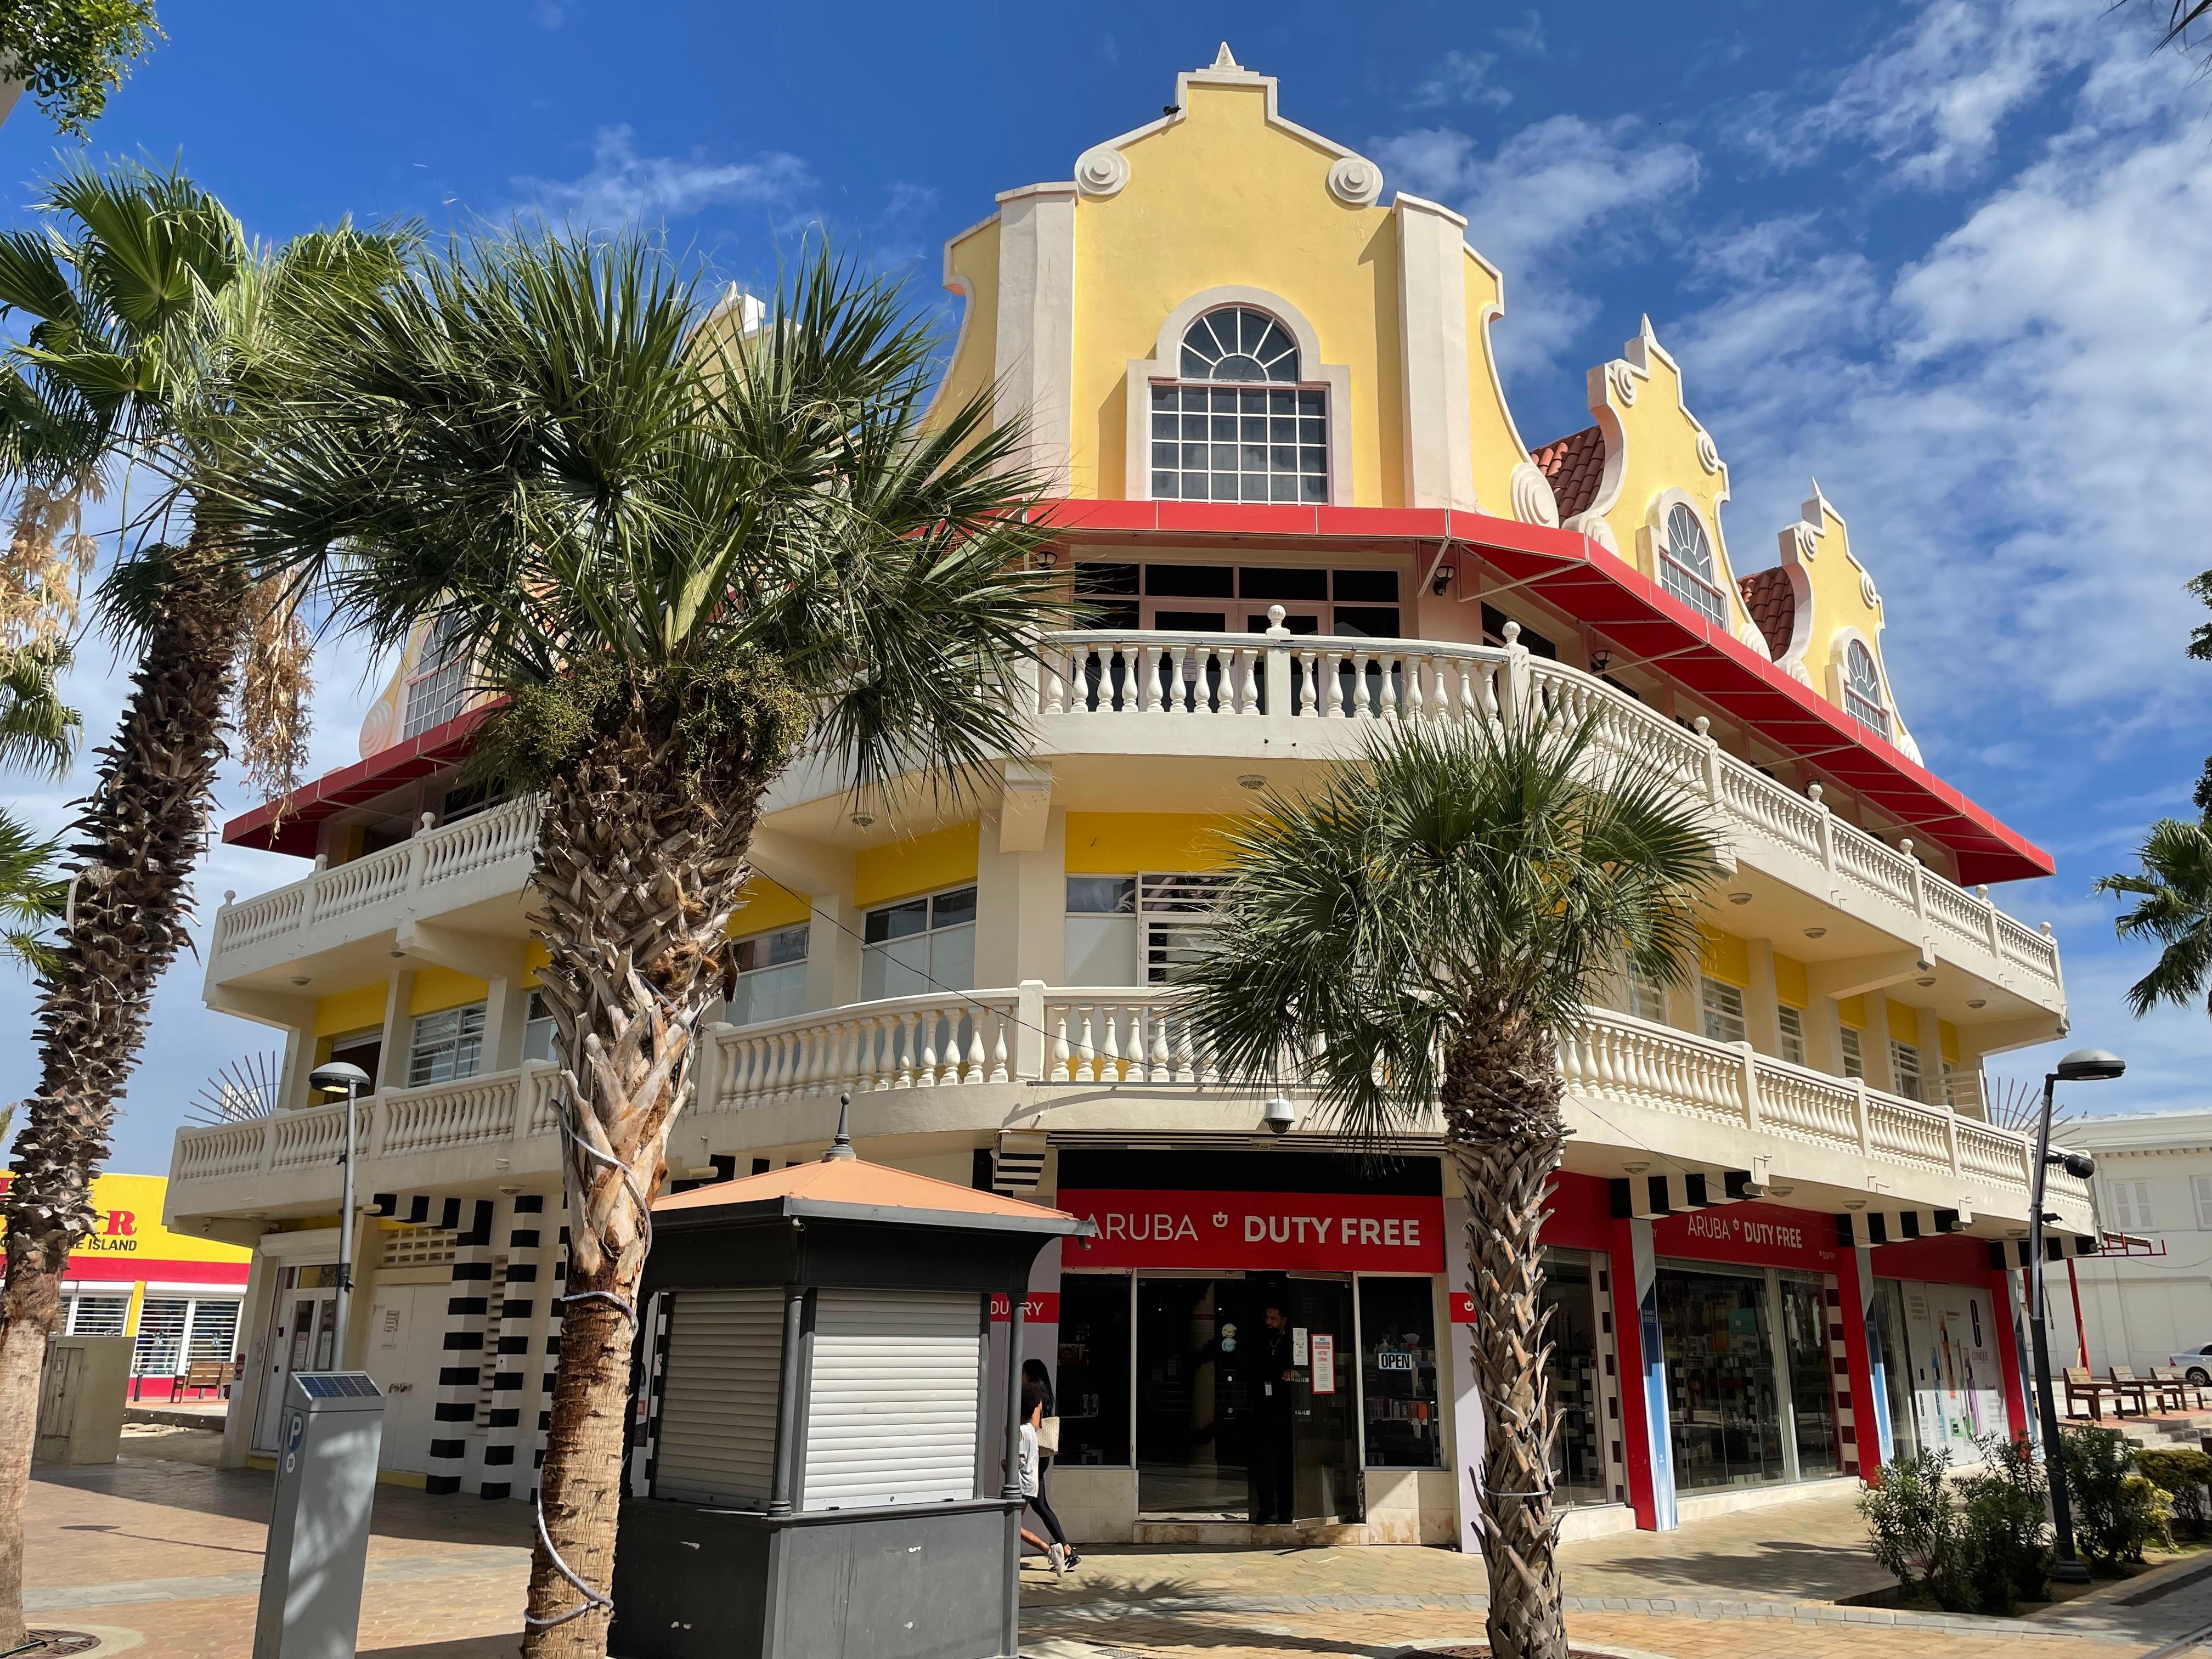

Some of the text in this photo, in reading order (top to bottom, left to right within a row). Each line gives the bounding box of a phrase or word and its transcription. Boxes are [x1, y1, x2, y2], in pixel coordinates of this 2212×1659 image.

[1086, 1212, 1421, 1246] ARUBA DUTY FREE
[1688, 1214, 1803, 1249] ARUBA DUTY FREE
[88, 1238, 138, 1251] ISLAND
[990, 1300, 1044, 1316] DURY
[1381, 1353, 1410, 1369] OPEN
[289, 1416, 302, 1447] P
